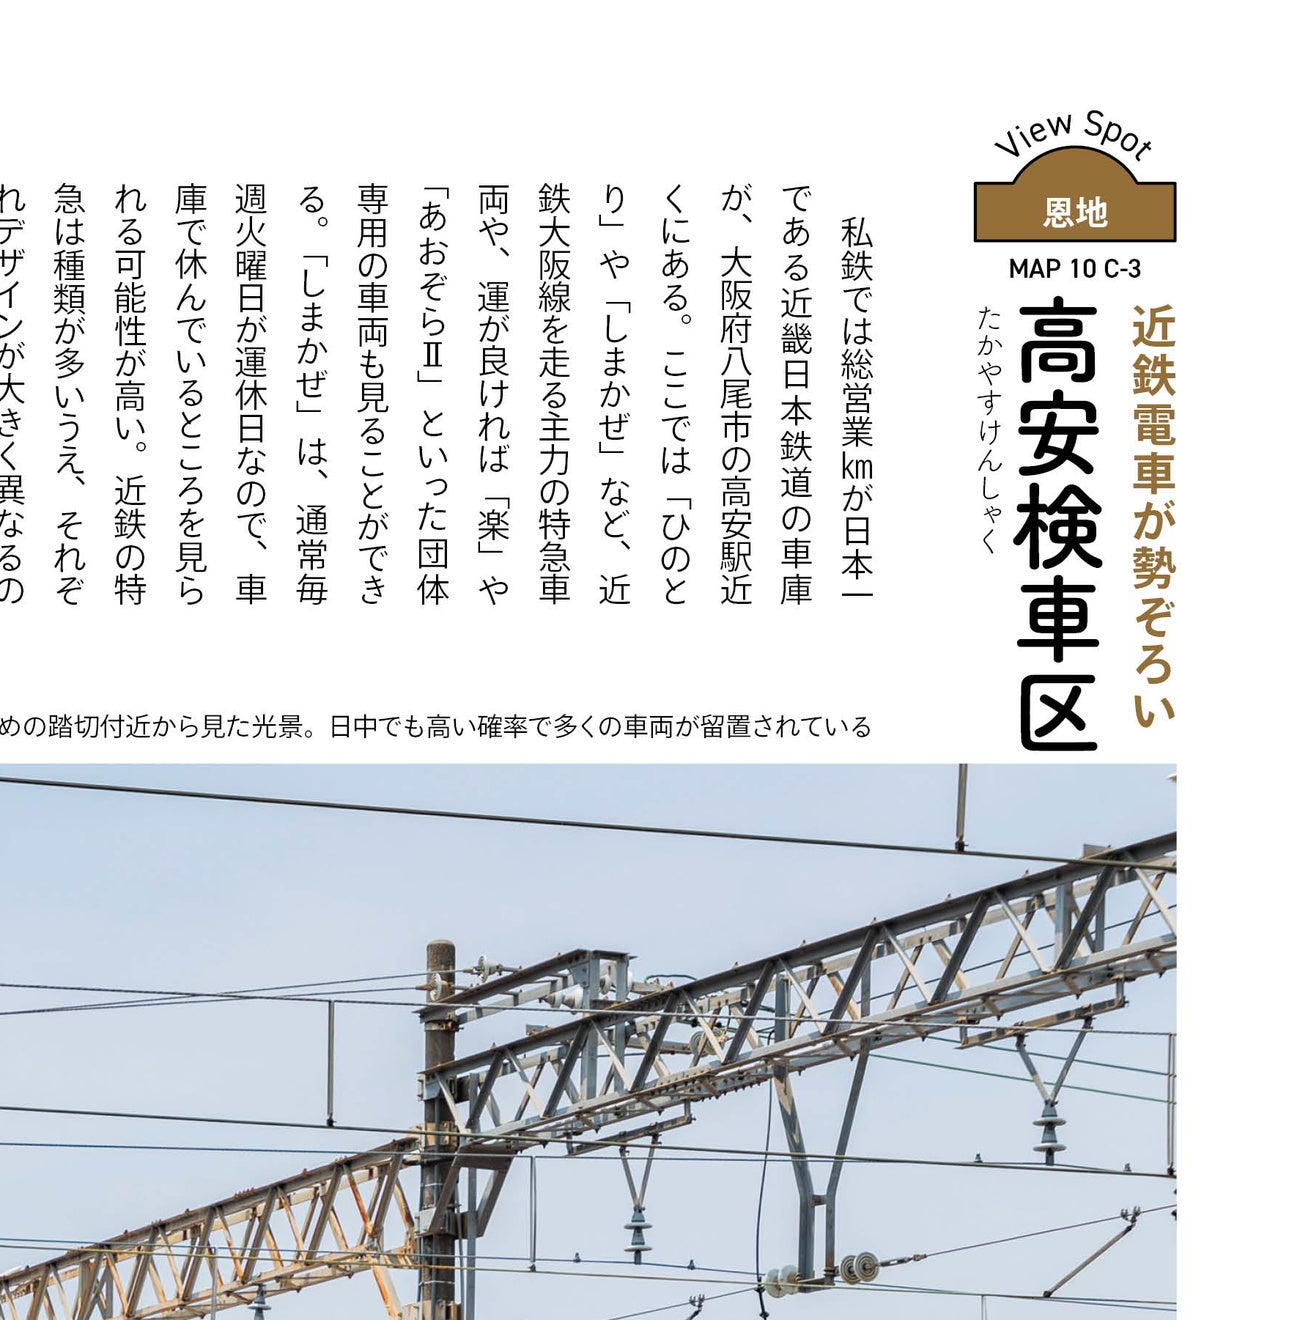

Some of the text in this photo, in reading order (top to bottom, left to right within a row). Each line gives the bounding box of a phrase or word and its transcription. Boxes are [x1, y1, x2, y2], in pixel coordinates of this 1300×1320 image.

[994, 109, 1153, 162] View Spot
[1010, 259, 1140, 278] MAP 10 C-3
[1043, 196, 1108, 228] 恩地
[54, 183, 85, 605] 急は種類が多いうえ、それぞ
[115, 184, 146, 605] れる可能性が高い。近鉄の特
[175, 183, 207, 605] 庫で休んでいるところを見ら
[236, 184, 267, 604] 週火曜日が運休日なので、車
[296, 187, 328, 605] る。「しまかぜ」は、通常毎
[358, 183, 388, 604] 専用の車両も見ることができ
[417, 188, 449, 605] 「あおぞらⅡ」といった団体
[478, 185, 510, 605] 両や、運が良ければ「楽」や
[539, 183, 570, 604] 鉄大阪線を走る主力の特急車
[599, 185, 631, 604] り」や「しまかぜ」など、近
[661, 184, 691, 604] くにある。ここでは「ひのと
[720, 184, 752, 604] が、大阪府八尾市の高安駅近
[781, 186, 812, 605] である近畿日本鉄道の車庫
[977, 307, 1002, 554] たかやすけんしゃく
[1013, 296, 1102, 751] 高安検車区
[1133, 304, 1176, 728] 近鉄電車が勢ぞろい
